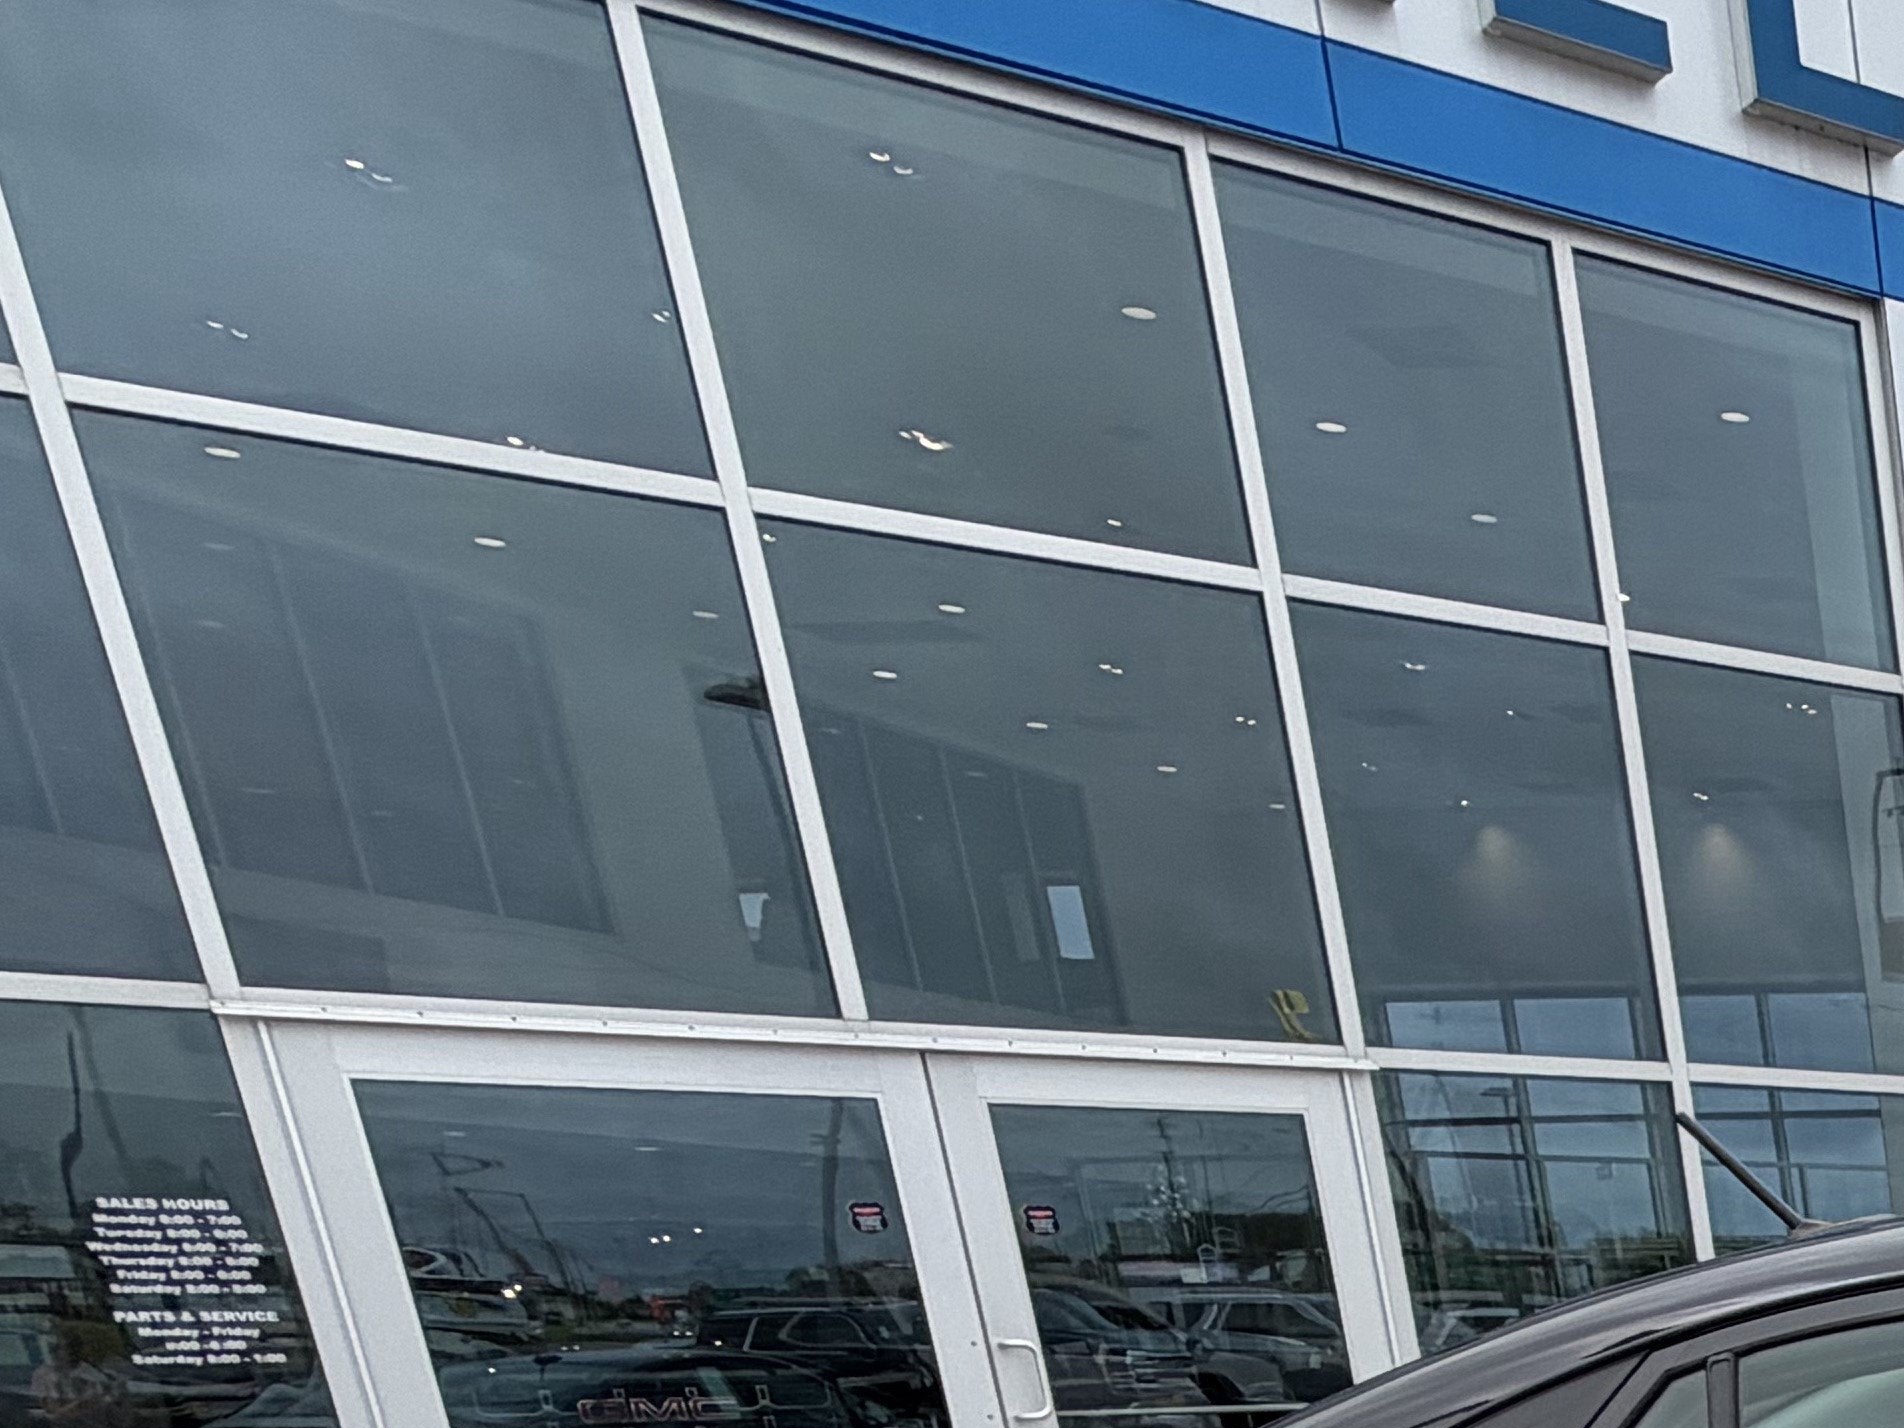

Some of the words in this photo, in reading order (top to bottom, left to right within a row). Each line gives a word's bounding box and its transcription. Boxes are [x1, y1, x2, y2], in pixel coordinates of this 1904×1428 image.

[95, 1197, 158, 1210] SALES
[162, 1198, 230, 1211] HOURS
[91, 1213, 156, 1226] Monday
[93, 1226, 163, 1240] Tuesday
[84, 1240, 178, 1254] Wednesday
[98, 1255, 175, 1268] Thursday
[116, 1269, 167, 1281] Friday
[109, 1283, 182, 1296] Saturday
[112, 1311, 176, 1323] PARTS
[181, 1311, 196, 1322] &
[199, 1311, 280, 1323] SERVICE
[137, 1327, 200, 1339] Monday
[211, 1327, 261, 1339] Friday
[131, 1354, 204, 1367] Saturday
